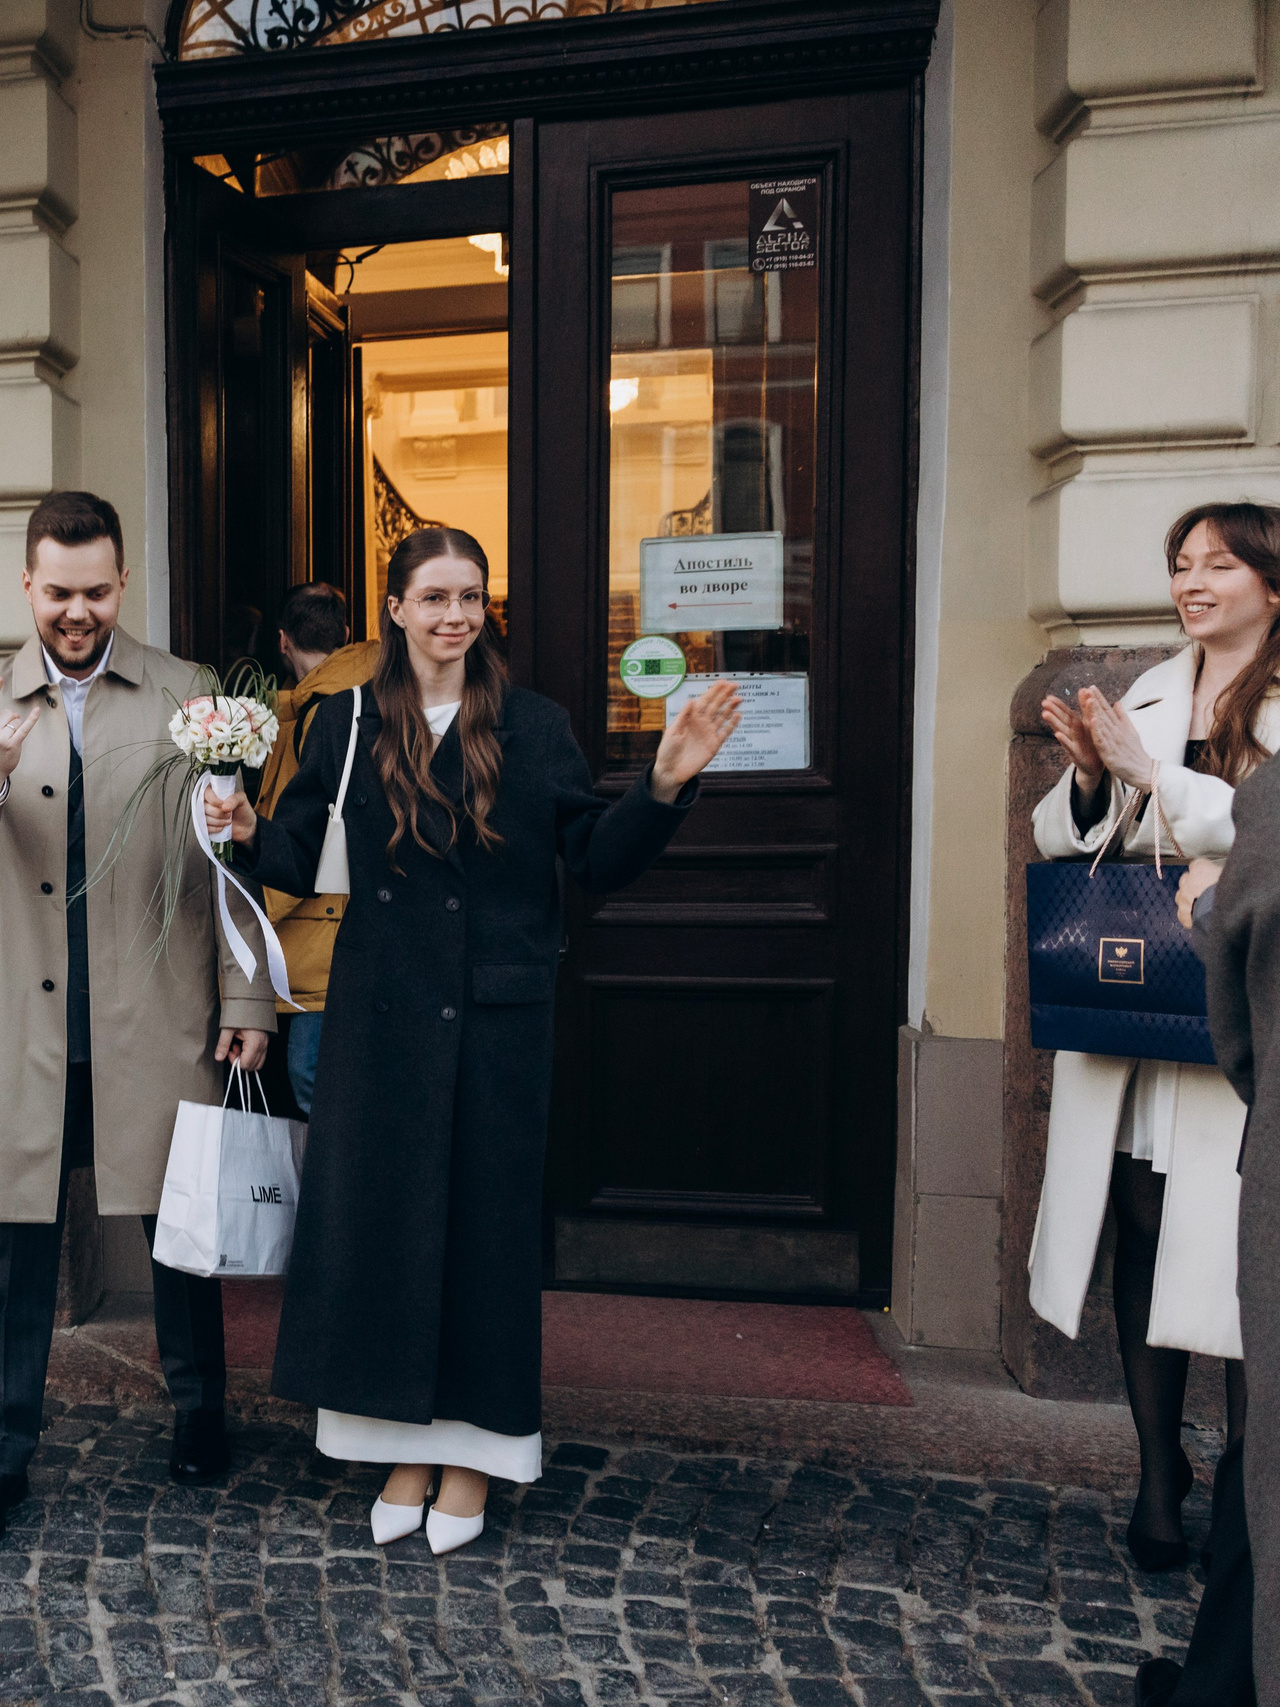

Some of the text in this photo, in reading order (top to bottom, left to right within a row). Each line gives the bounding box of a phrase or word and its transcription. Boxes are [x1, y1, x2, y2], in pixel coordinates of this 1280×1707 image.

[750, 178, 817, 190] ОБЪЕКТ НАХОДИТСЯ
[775, 185, 806, 194] ОХРАНОЙ
[756, 231, 810, 245] ALPHA
[756, 240, 810, 254] SECTOR
[674, 556, 753, 571] Апостиль
[680, 581, 749, 595] во дворе
